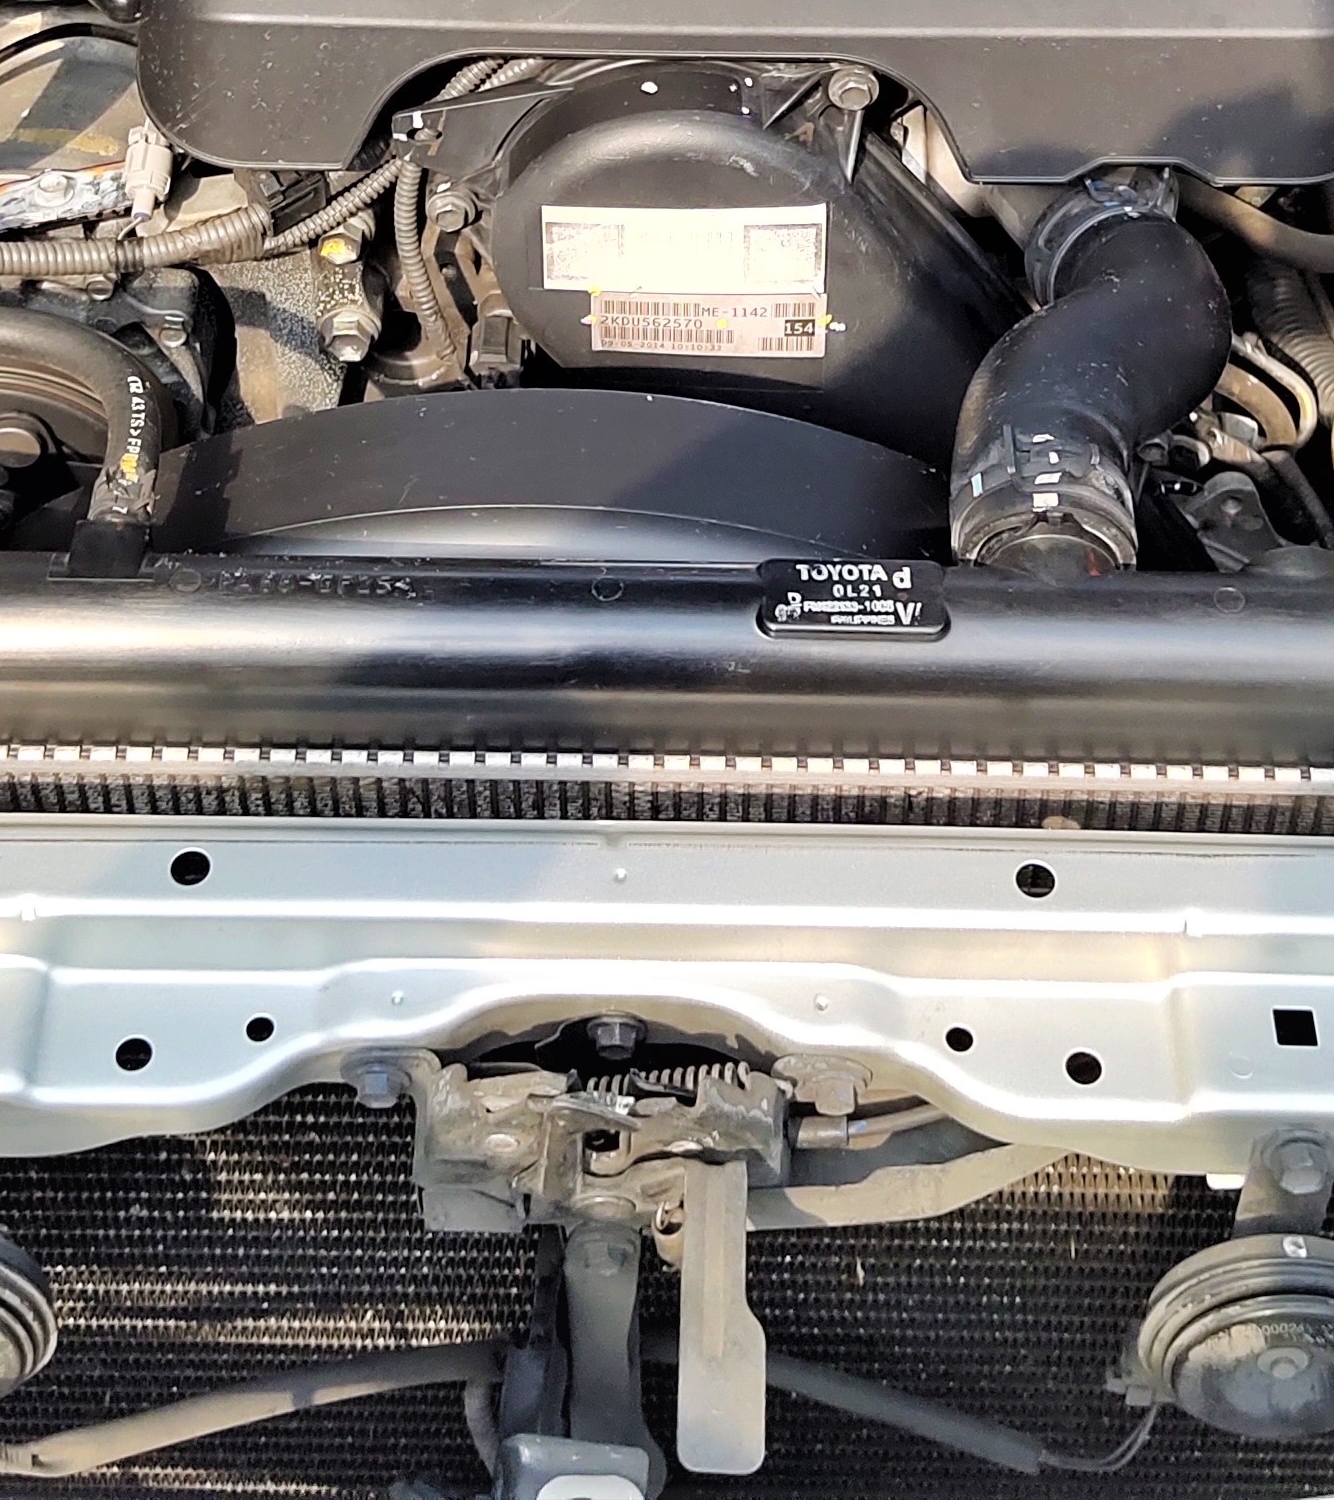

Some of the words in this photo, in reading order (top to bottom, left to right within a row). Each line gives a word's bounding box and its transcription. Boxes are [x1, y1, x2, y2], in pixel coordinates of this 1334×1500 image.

[702, 307, 768, 318] ME-1142
[600, 315, 703, 329] 2KDU562570
[785, 321, 815, 335] 154
[795, 564, 889, 581] TOYOTA
[833, 584, 882, 598] 0L21
